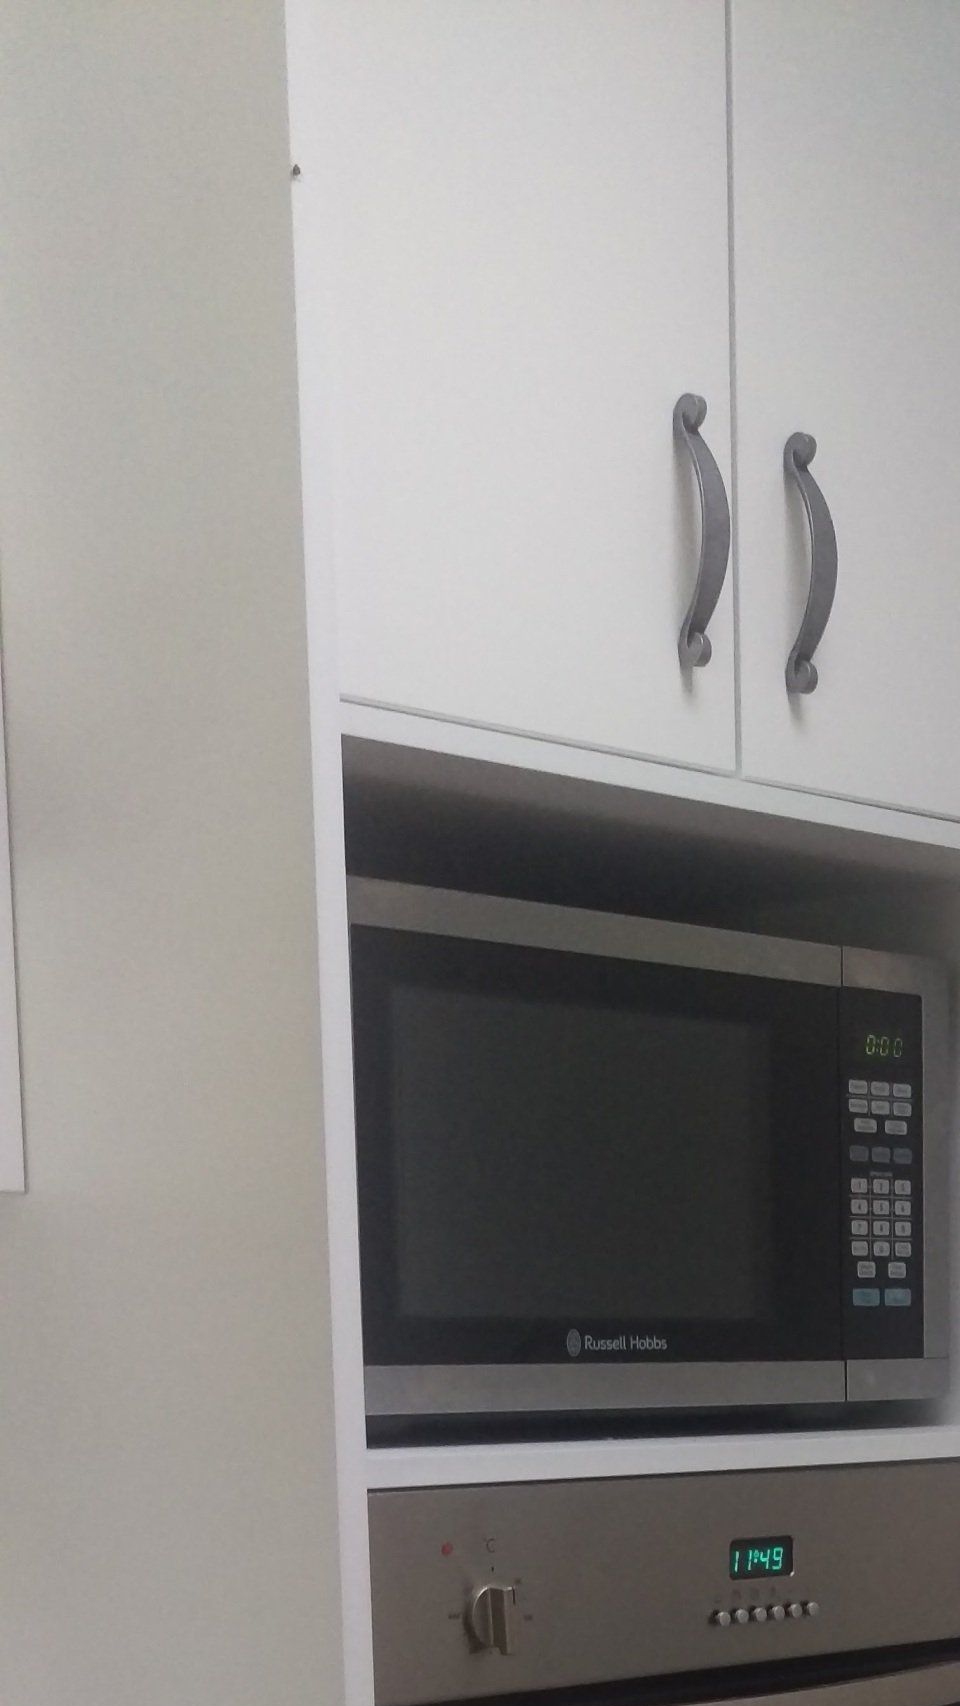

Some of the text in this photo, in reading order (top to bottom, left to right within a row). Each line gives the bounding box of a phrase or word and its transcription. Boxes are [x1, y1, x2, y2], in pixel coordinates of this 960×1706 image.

[865, 1033, 903, 1058] 0:00
[584, 1335, 668, 1351] Russell Hobbs
[734, 1546, 784, 1573] 11:49
